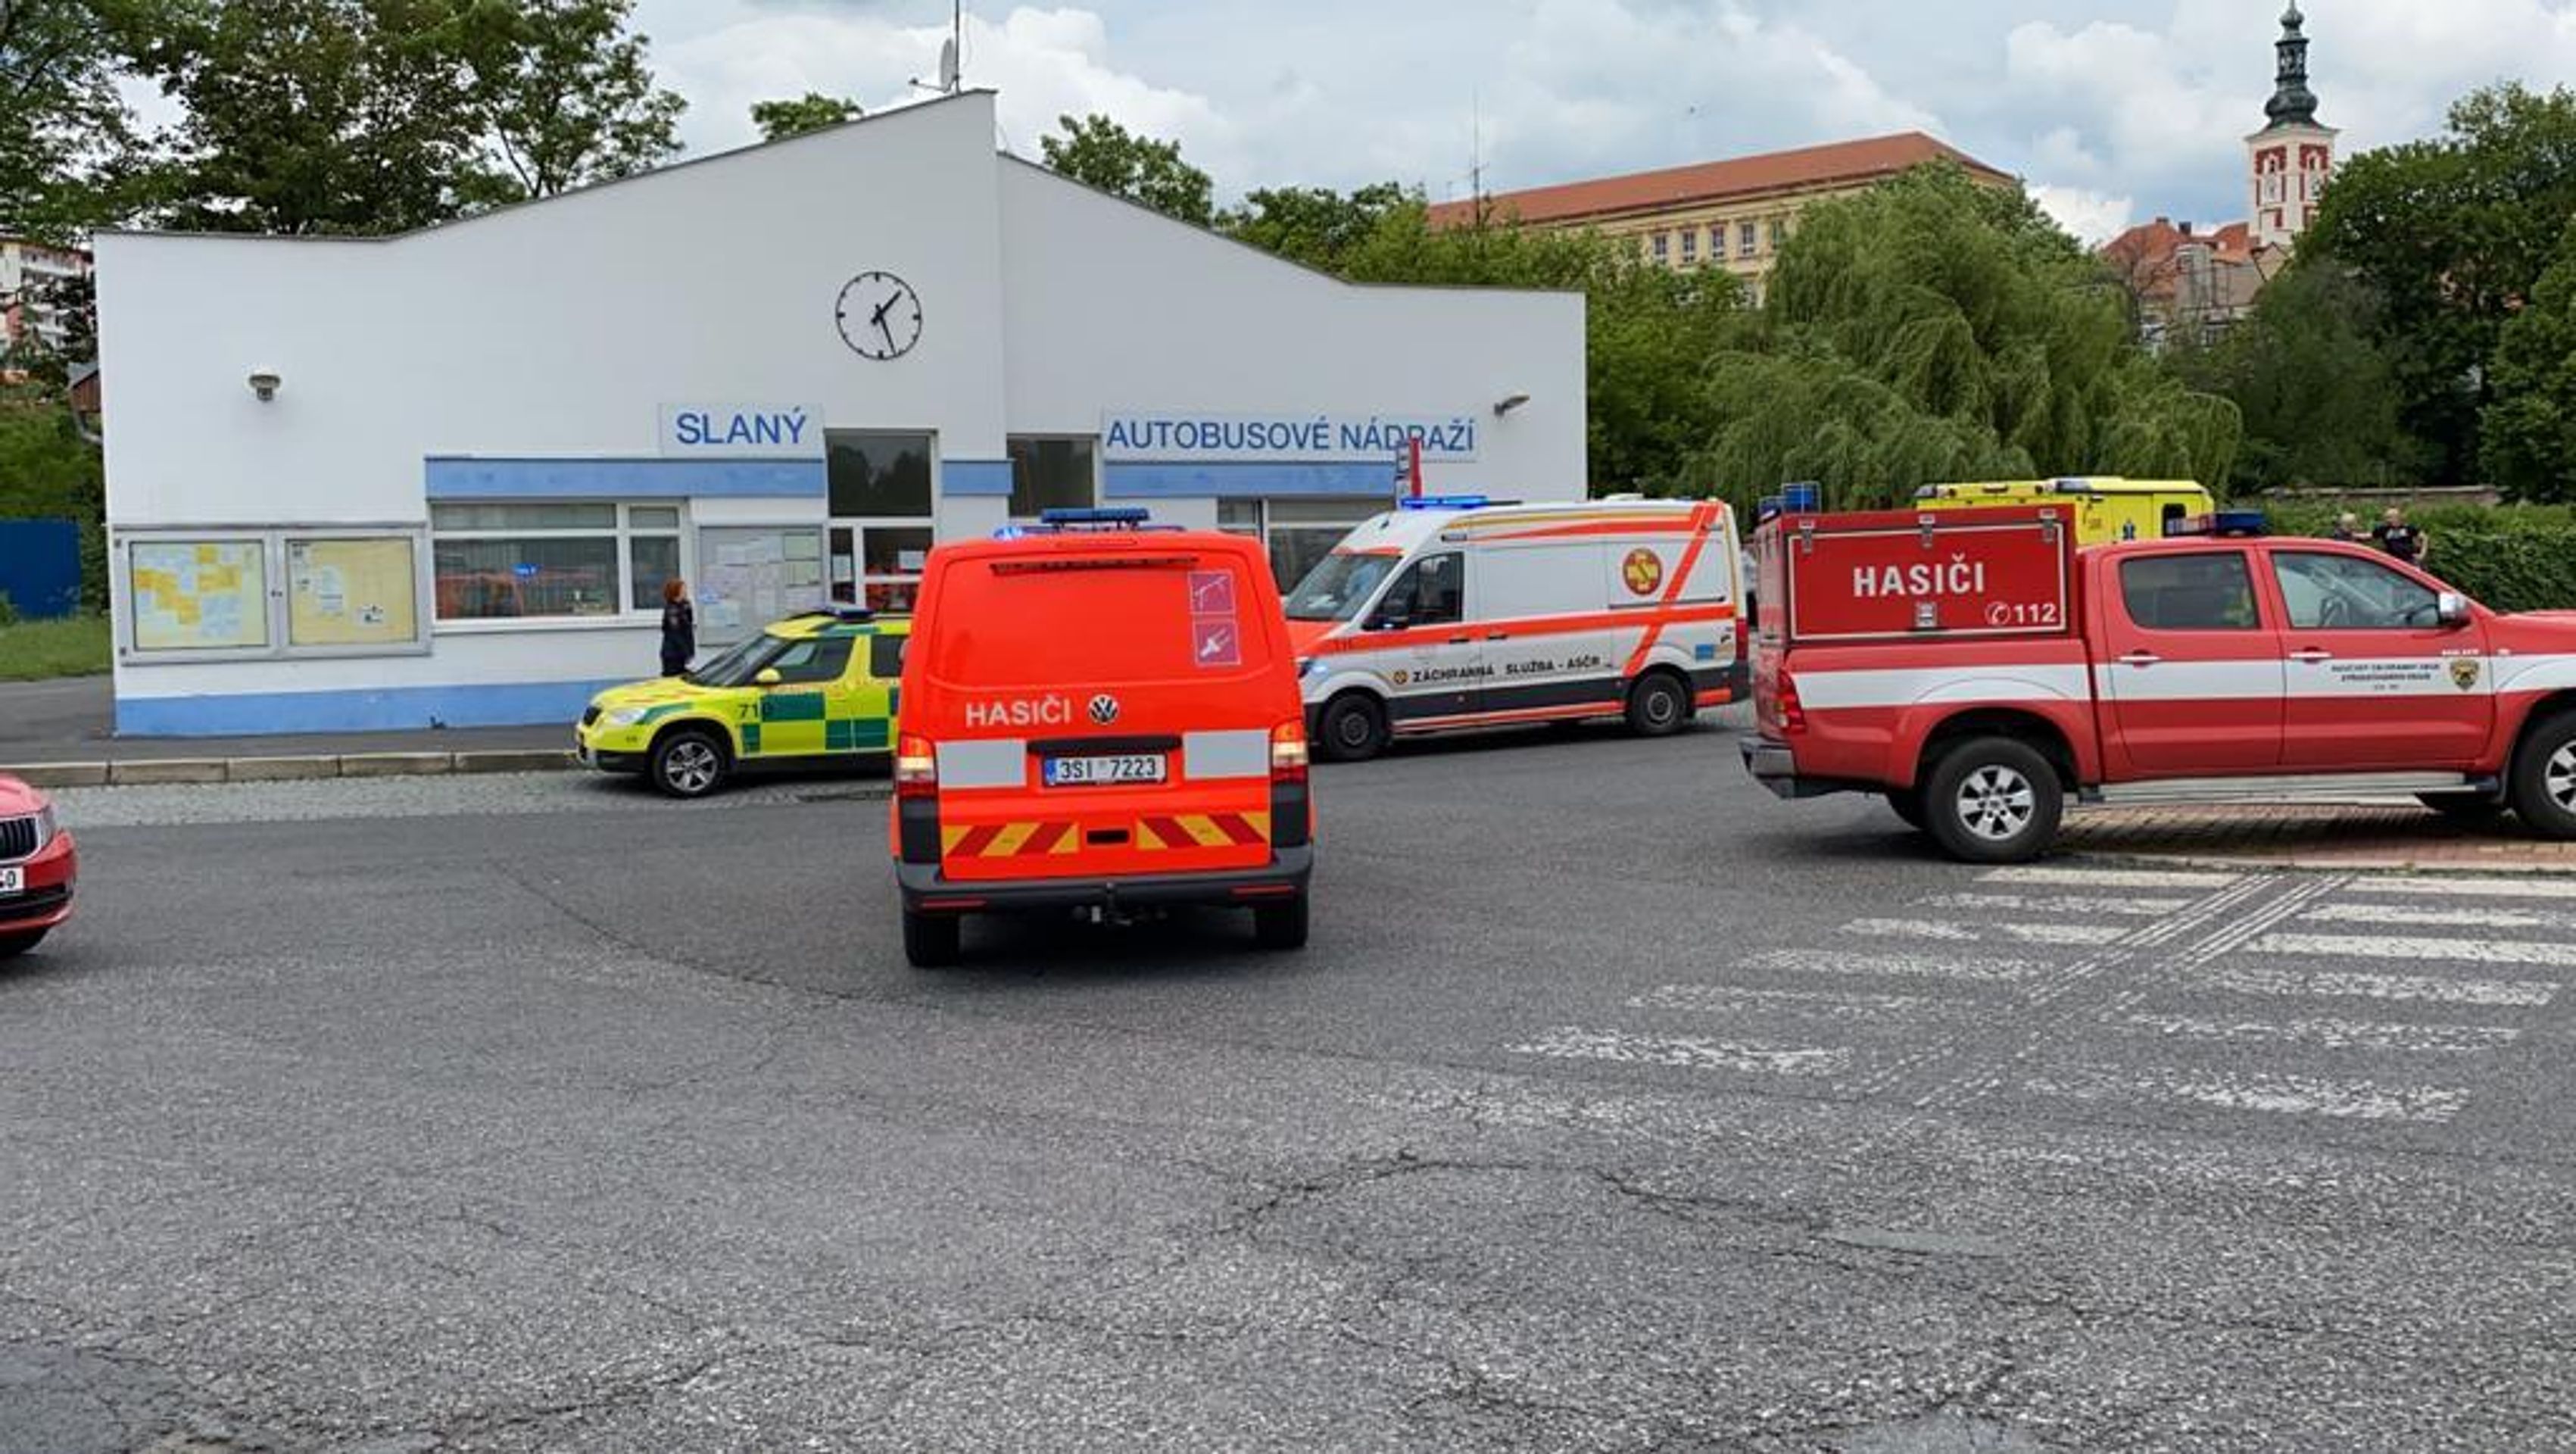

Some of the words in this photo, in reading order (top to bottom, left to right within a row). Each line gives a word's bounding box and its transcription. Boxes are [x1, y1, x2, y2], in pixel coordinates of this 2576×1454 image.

[676, 406, 806, 444] SLANÝ
[1106, 415, 1330, 450] AUTOBUSOVÉ
[1340, 417, 1474, 451] NÁDRAŽÍ
[1853, 552, 1985, 598] HASIČI
[2014, 604, 2057, 623] 112
[965, 694, 1071, 727] HASIČI
[1110, 759, 1156, 777] 7223
